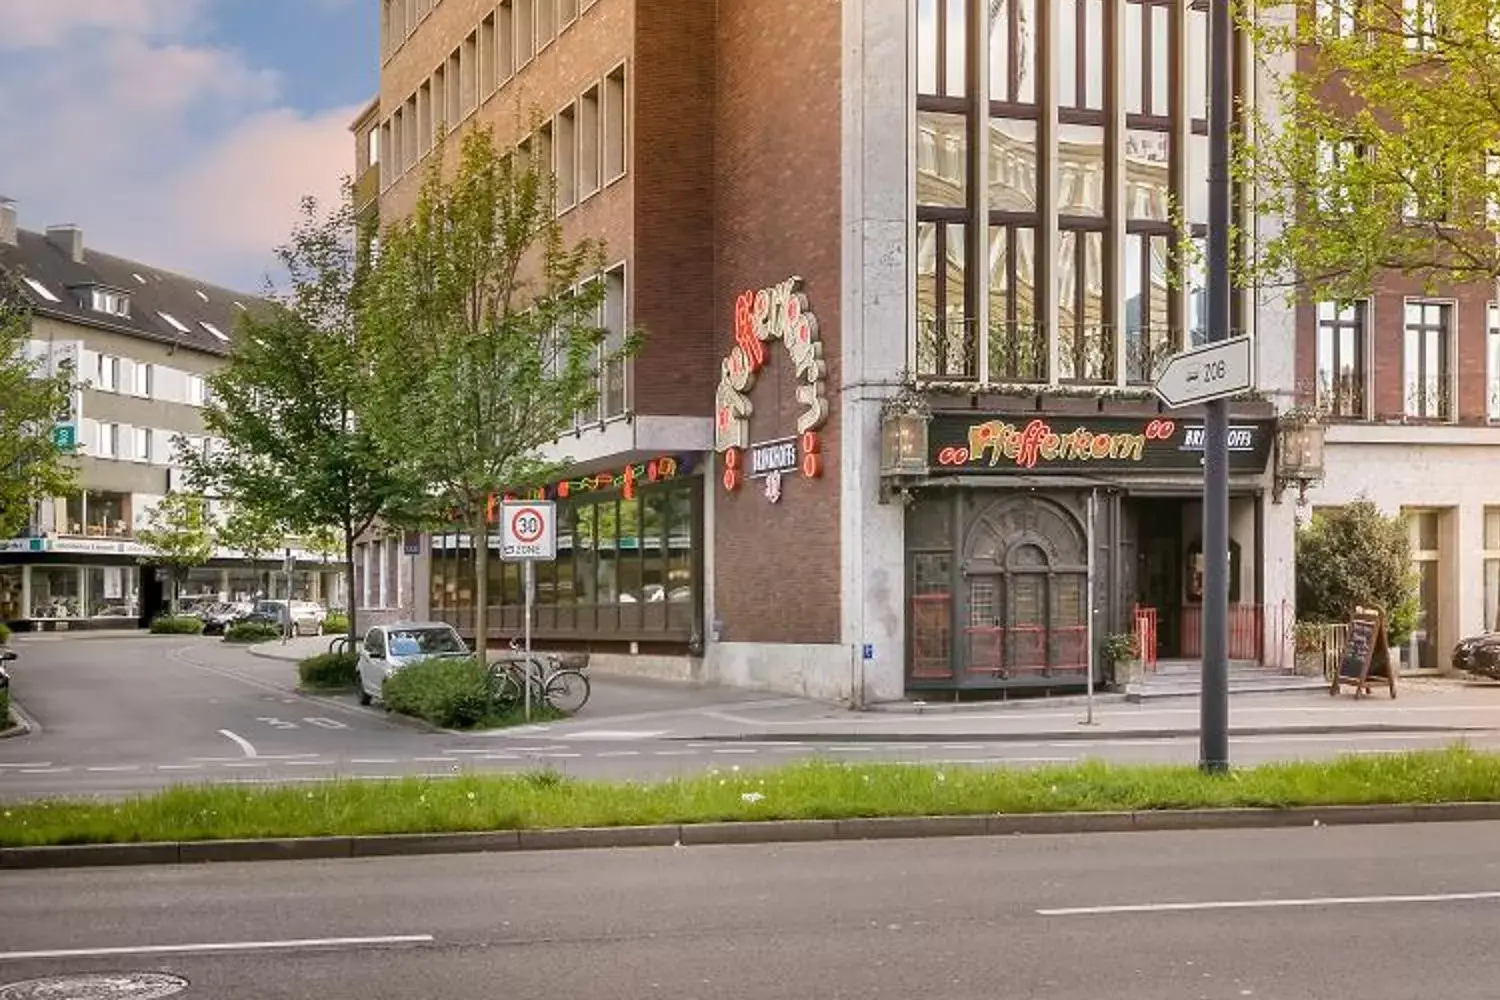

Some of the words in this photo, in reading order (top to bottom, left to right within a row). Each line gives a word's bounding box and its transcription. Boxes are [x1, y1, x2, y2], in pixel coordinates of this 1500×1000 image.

[968, 420, 1146, 467] Pfefferkorn
[519, 517, 537, 534] 30
[516, 545, 541, 555] ZONE
